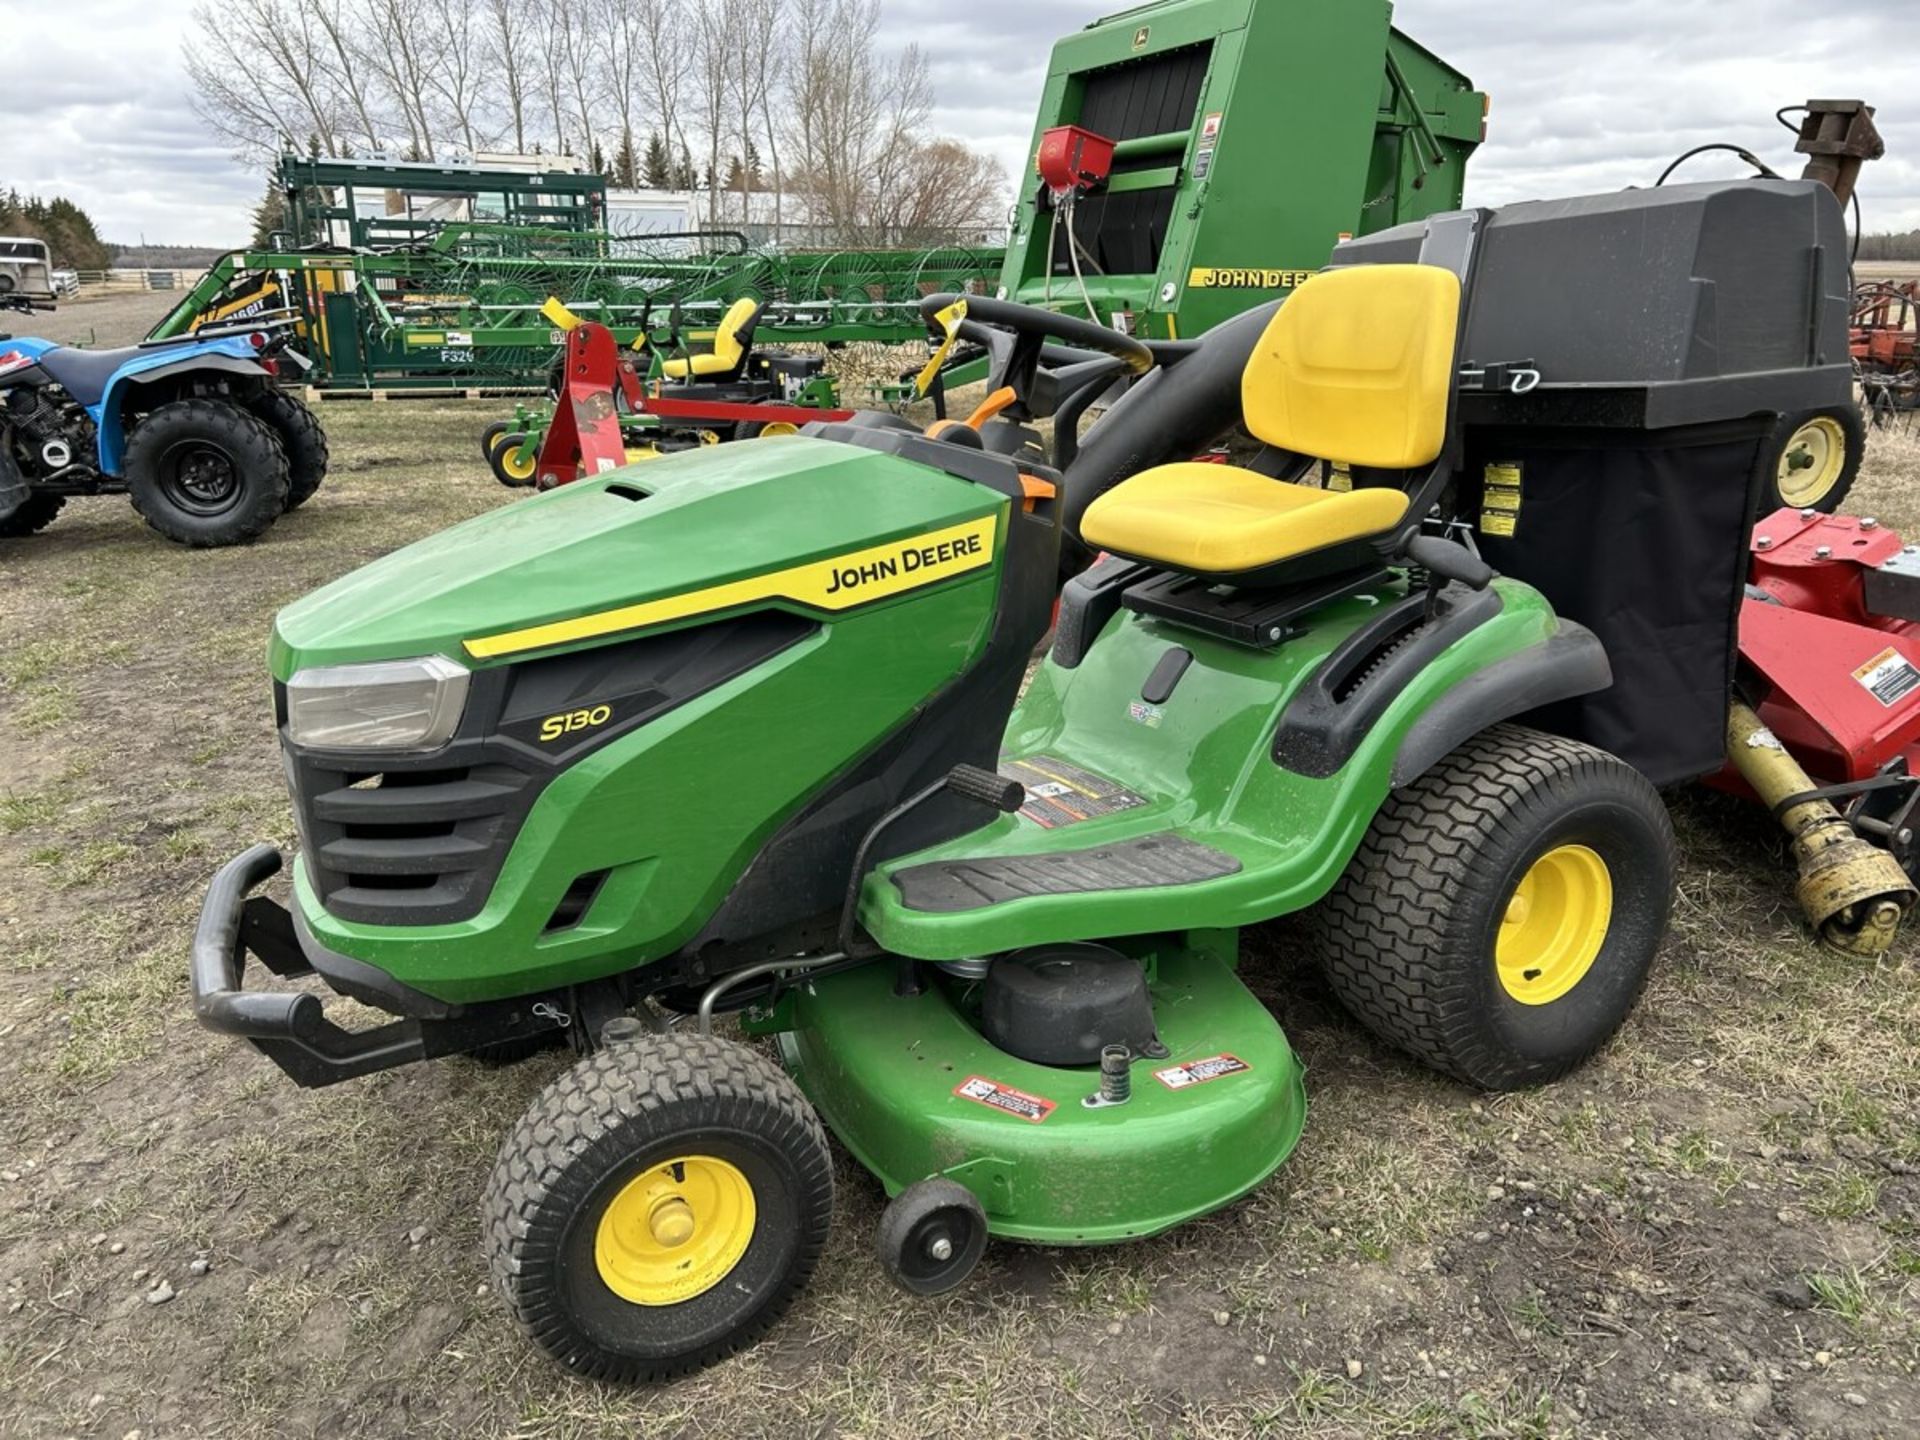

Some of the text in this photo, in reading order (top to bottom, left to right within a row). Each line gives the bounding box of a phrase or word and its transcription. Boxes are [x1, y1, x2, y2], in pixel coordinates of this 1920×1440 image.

[1205, 270, 1262, 288] JOHN
[826, 534, 982, 594] JOHN DEERE
[540, 704, 612, 742] S130
